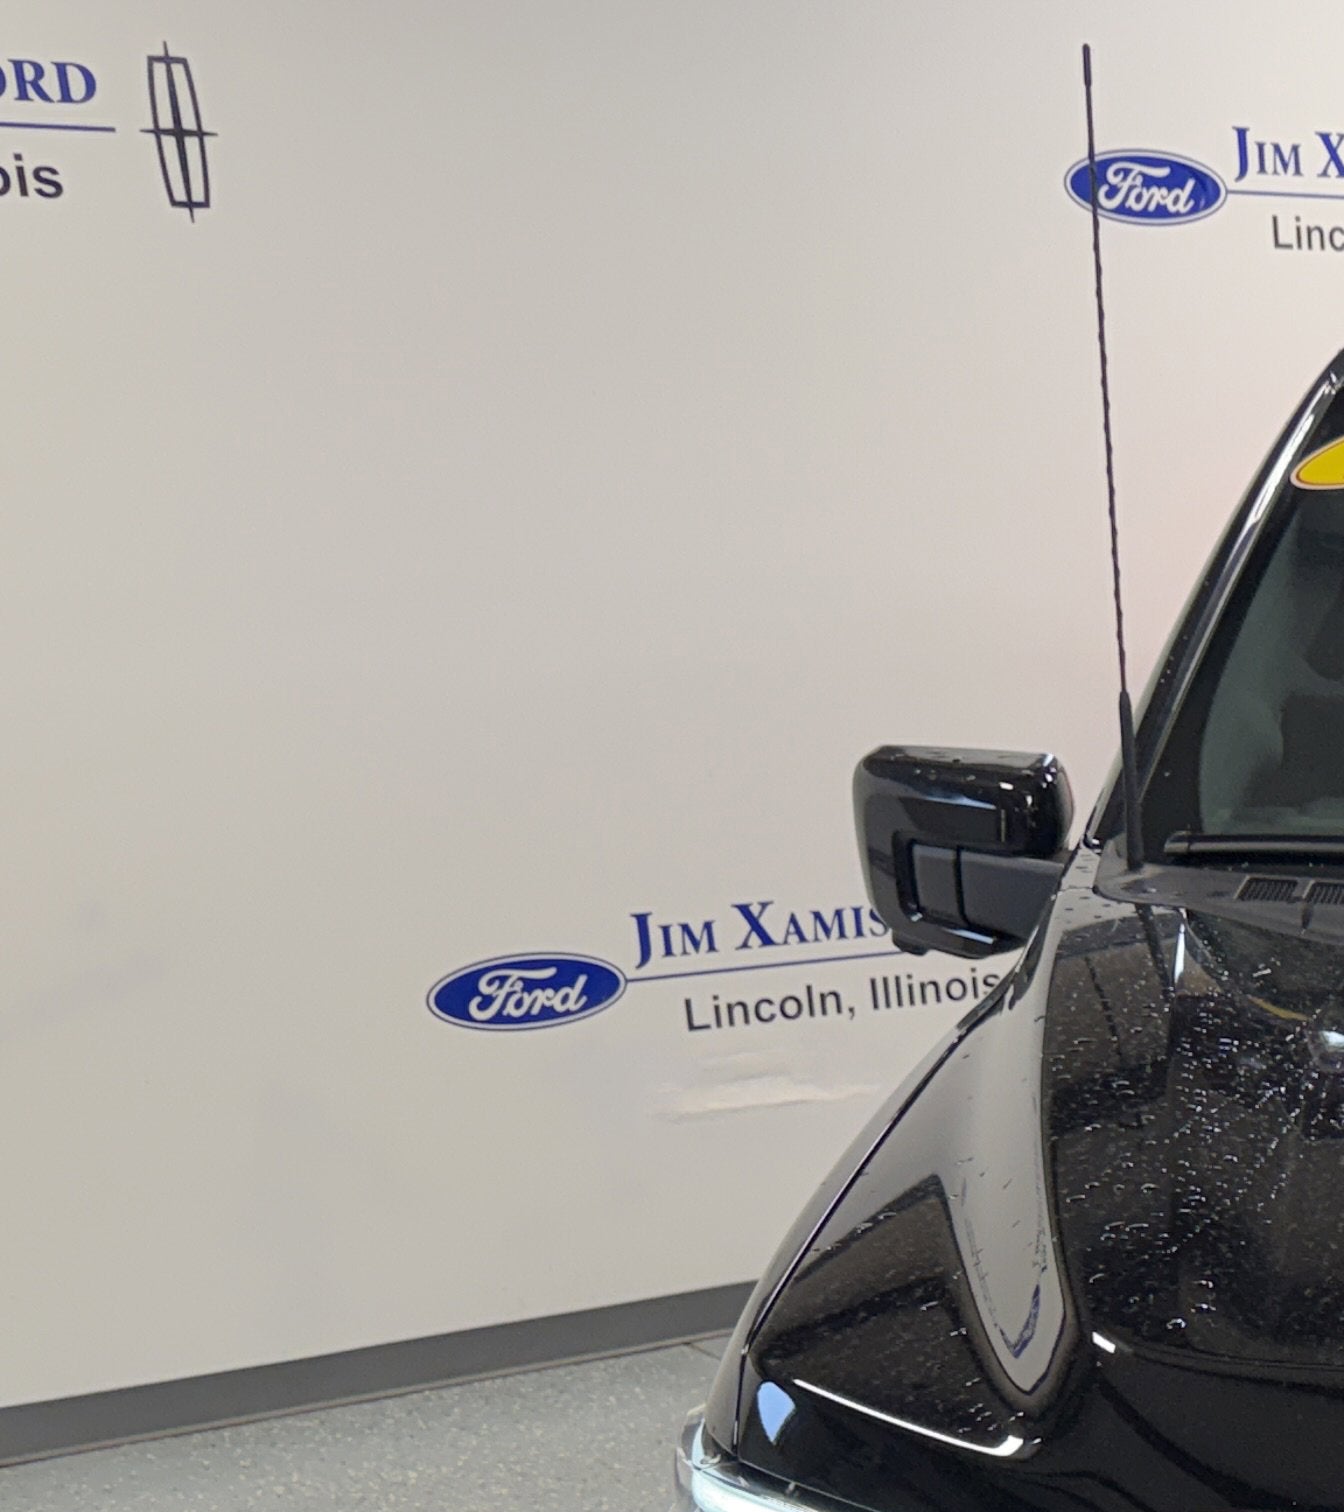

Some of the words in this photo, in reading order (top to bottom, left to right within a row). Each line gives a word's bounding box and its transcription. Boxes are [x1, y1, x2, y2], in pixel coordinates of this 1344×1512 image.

[0, 58, 97, 104] RD
[1231, 125, 1305, 182] JIM
[1098, 160, 1196, 215] Ford
[628, 910, 720, 970] JIM
[729, 900, 889, 952] XAMIS
[467, 966, 588, 1022] Ford
[684, 984, 856, 1033] Lincoln,
[869, 966, 1001, 1010] Illinois
